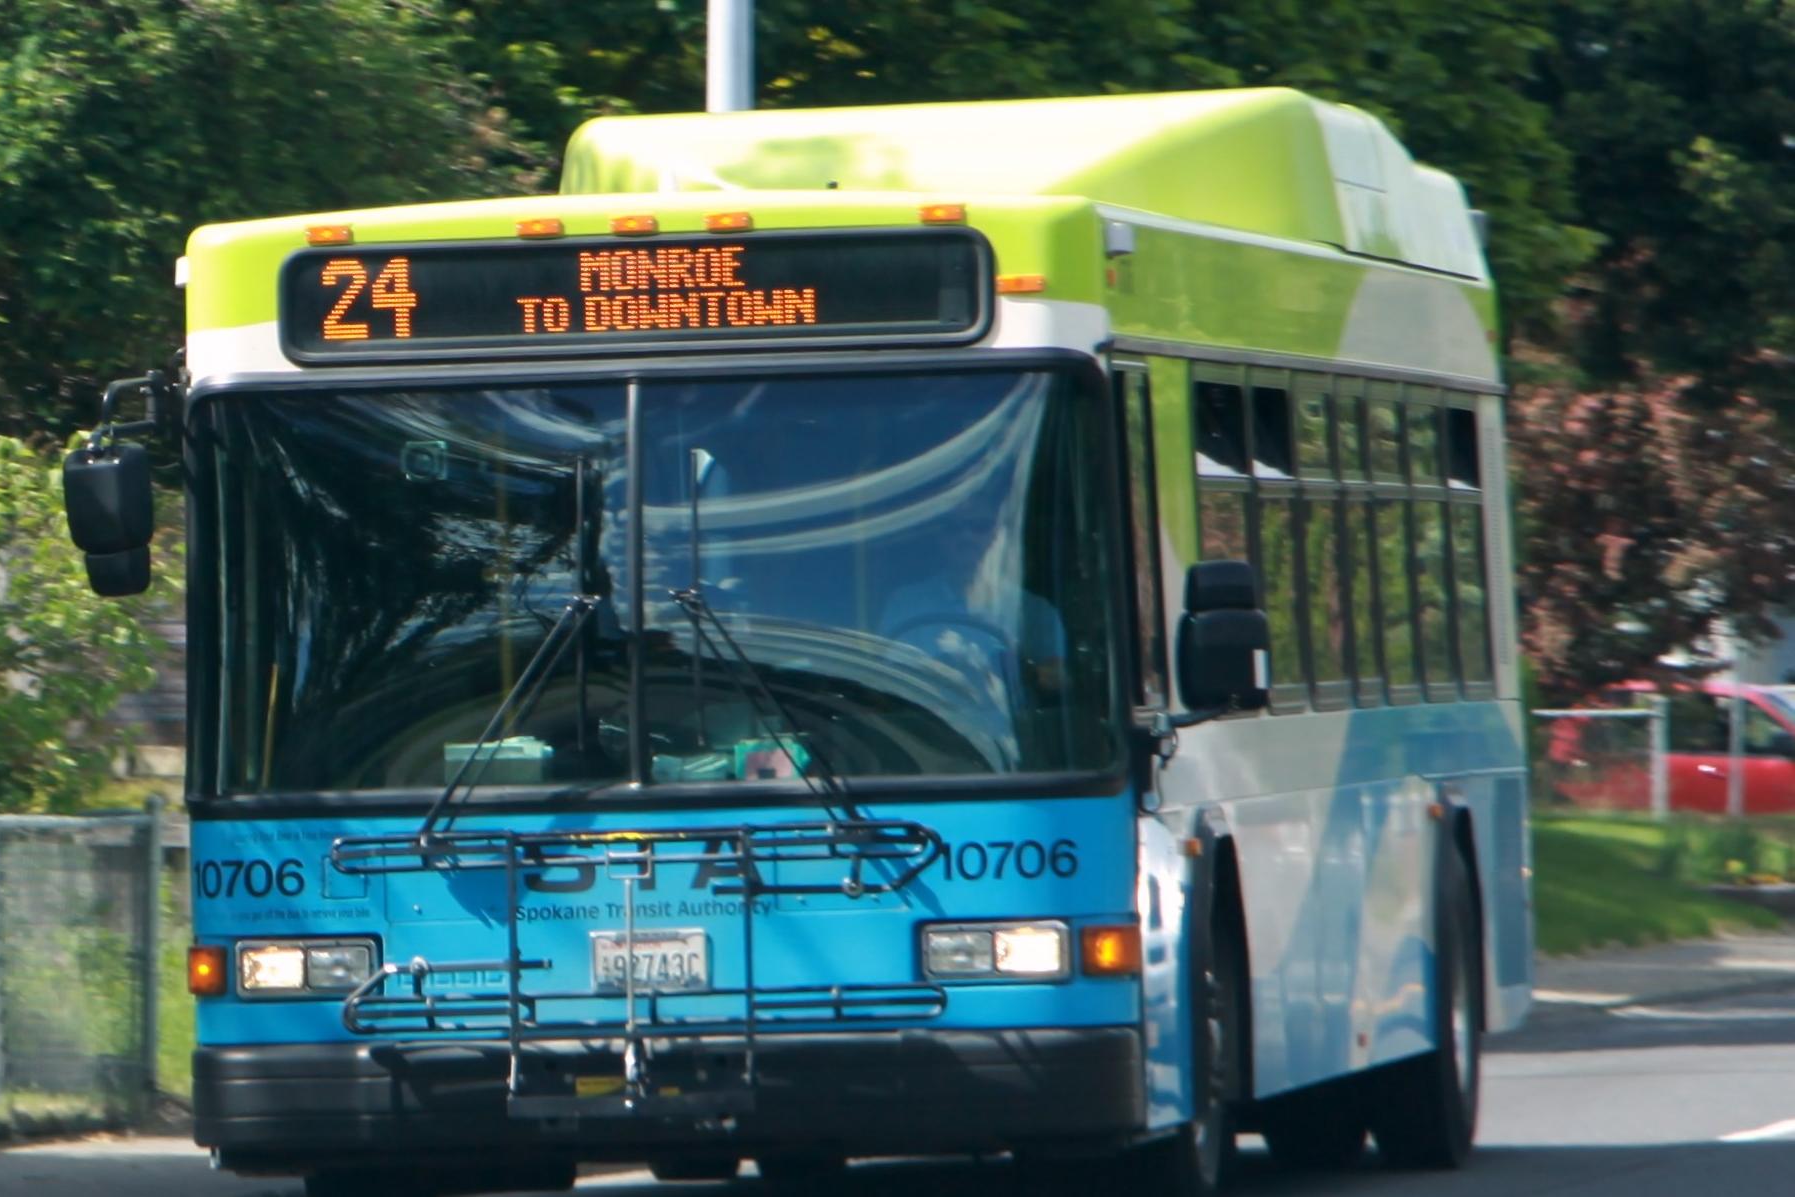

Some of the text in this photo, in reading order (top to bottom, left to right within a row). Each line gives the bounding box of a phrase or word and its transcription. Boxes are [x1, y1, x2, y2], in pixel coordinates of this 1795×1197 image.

[579, 246, 745, 292] MONROE
[322, 258, 417, 340] 24
[517, 287, 816, 334] TO DOWNTOWN
[193, 858, 306, 899] 10706
[941, 838, 1079, 881] 10706
[515, 904, 599, 922] Spokane
[606, 901, 671, 919] Trnsit
